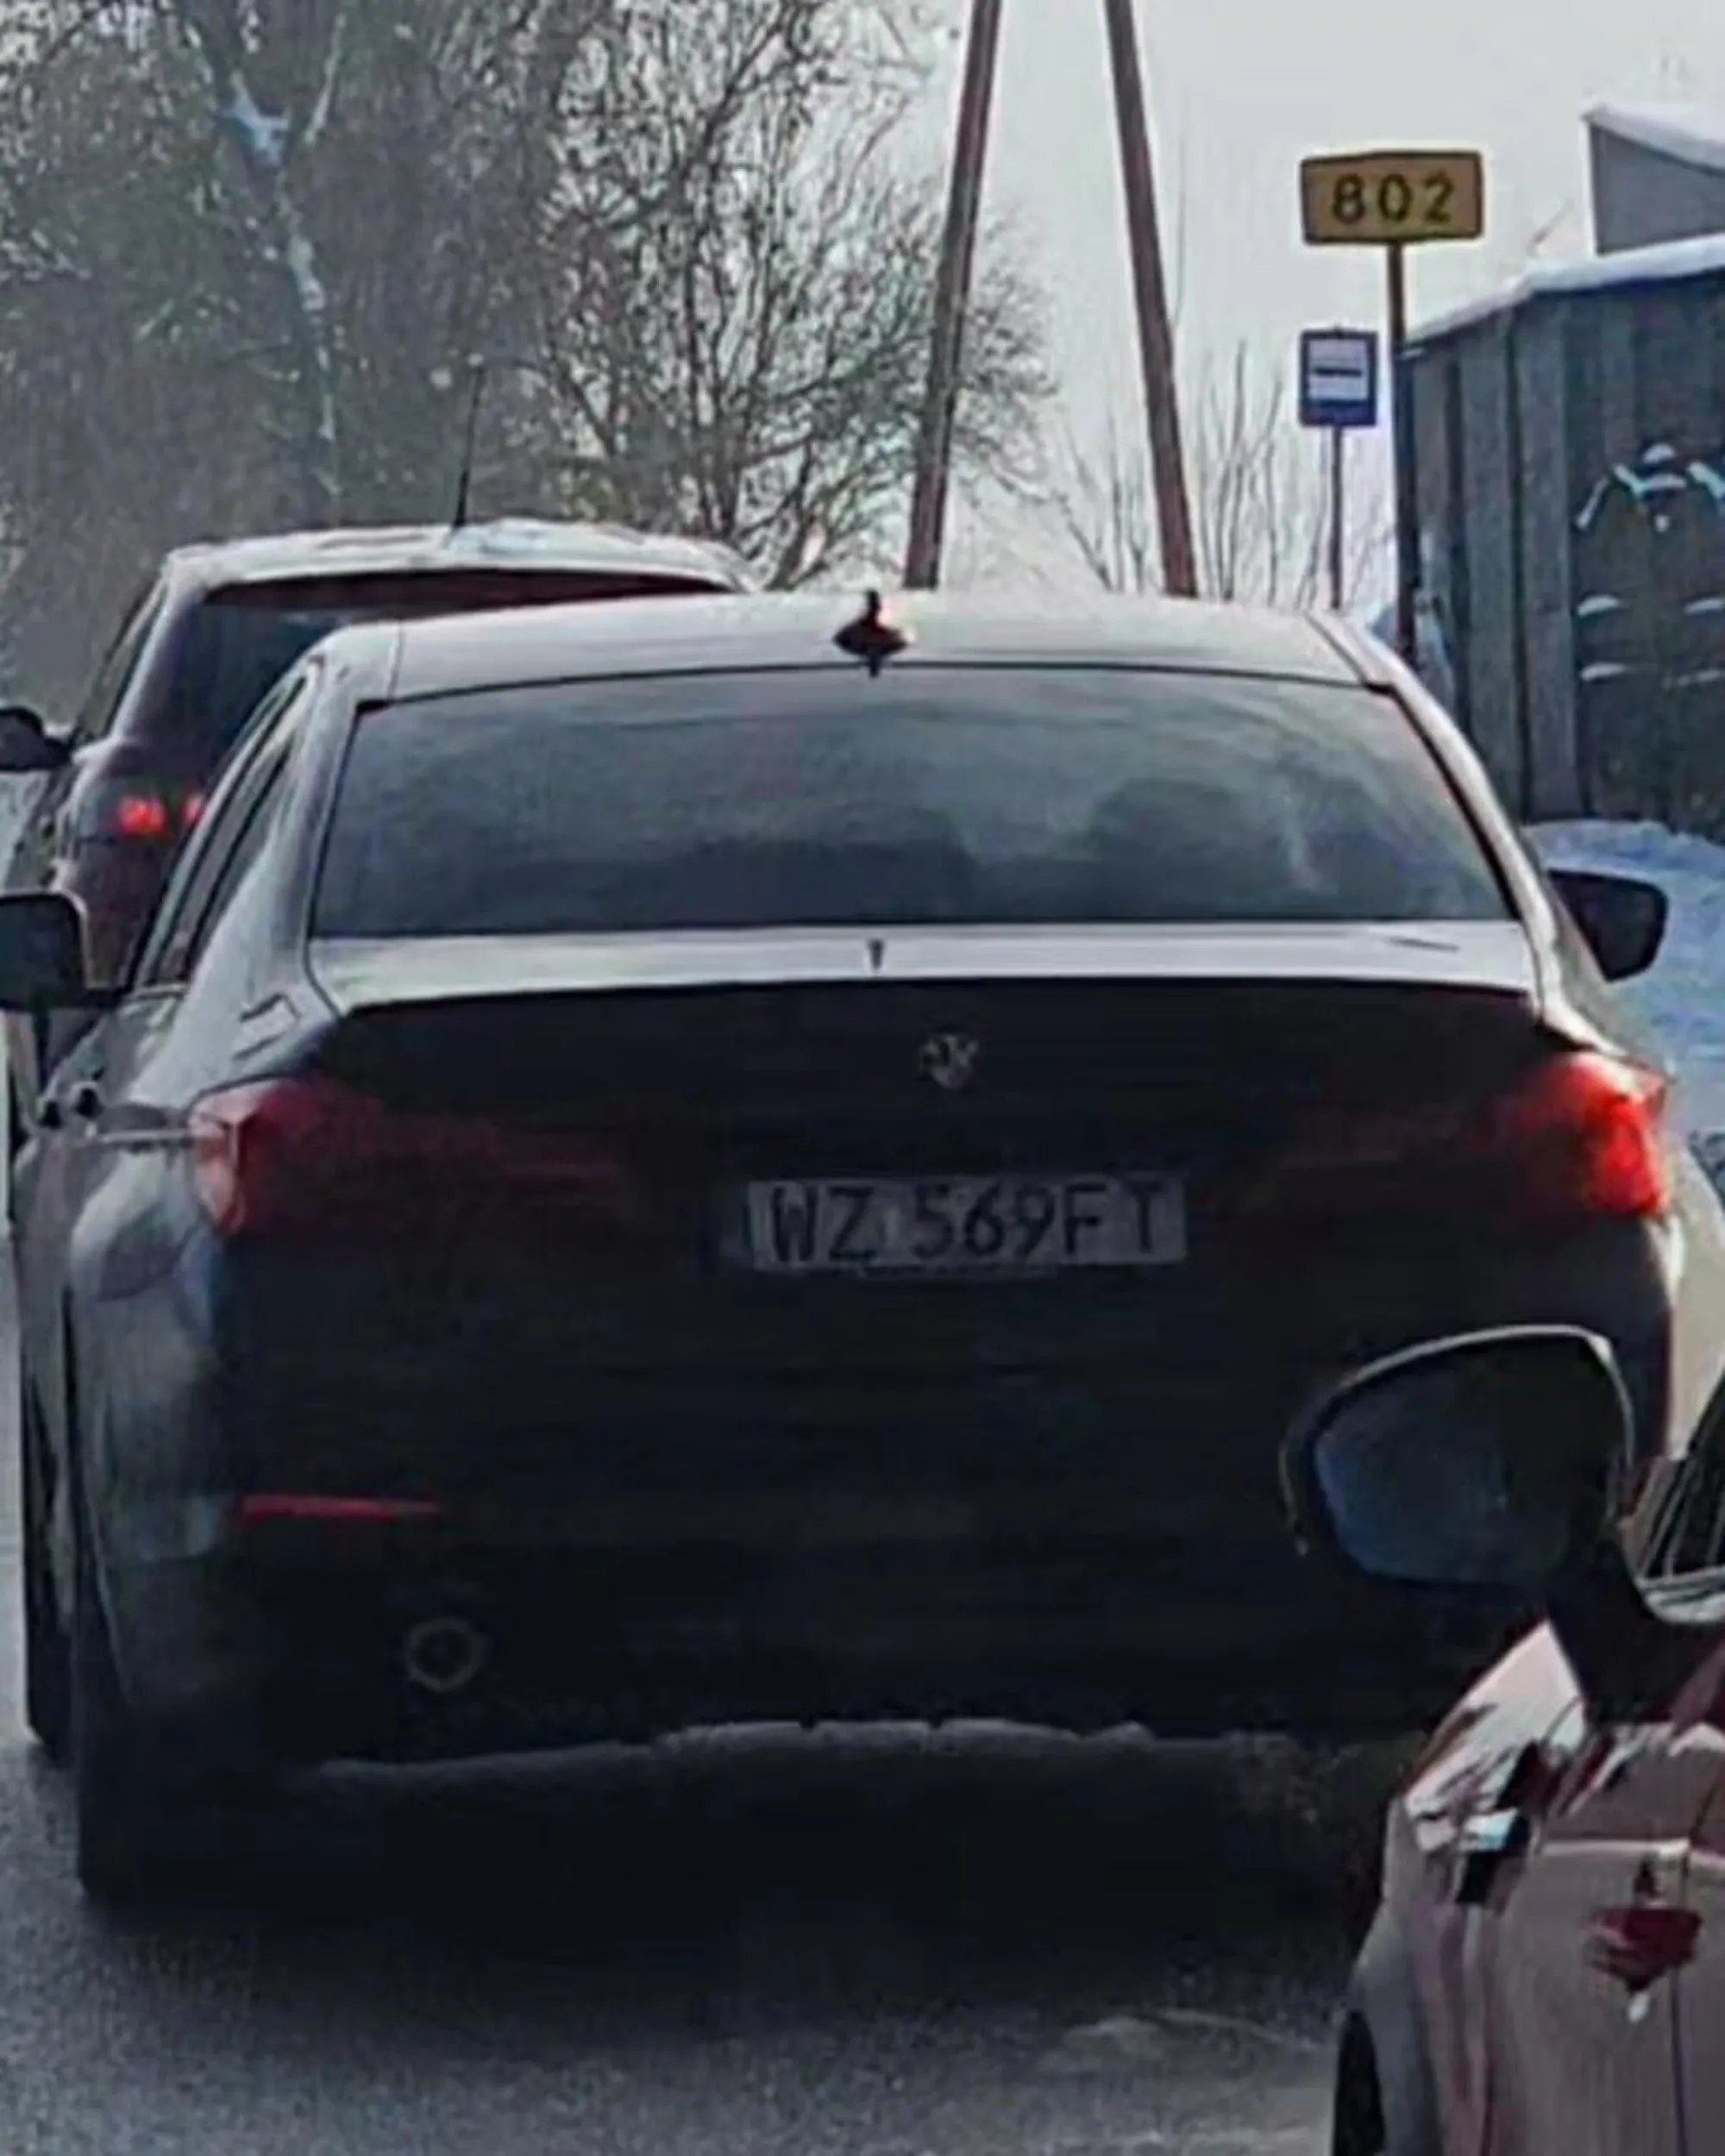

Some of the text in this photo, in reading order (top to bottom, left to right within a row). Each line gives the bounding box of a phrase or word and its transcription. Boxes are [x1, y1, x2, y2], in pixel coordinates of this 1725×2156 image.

[1333, 172, 1454, 223] 802
[770, 1181, 1165, 1263] WZ 569FT
